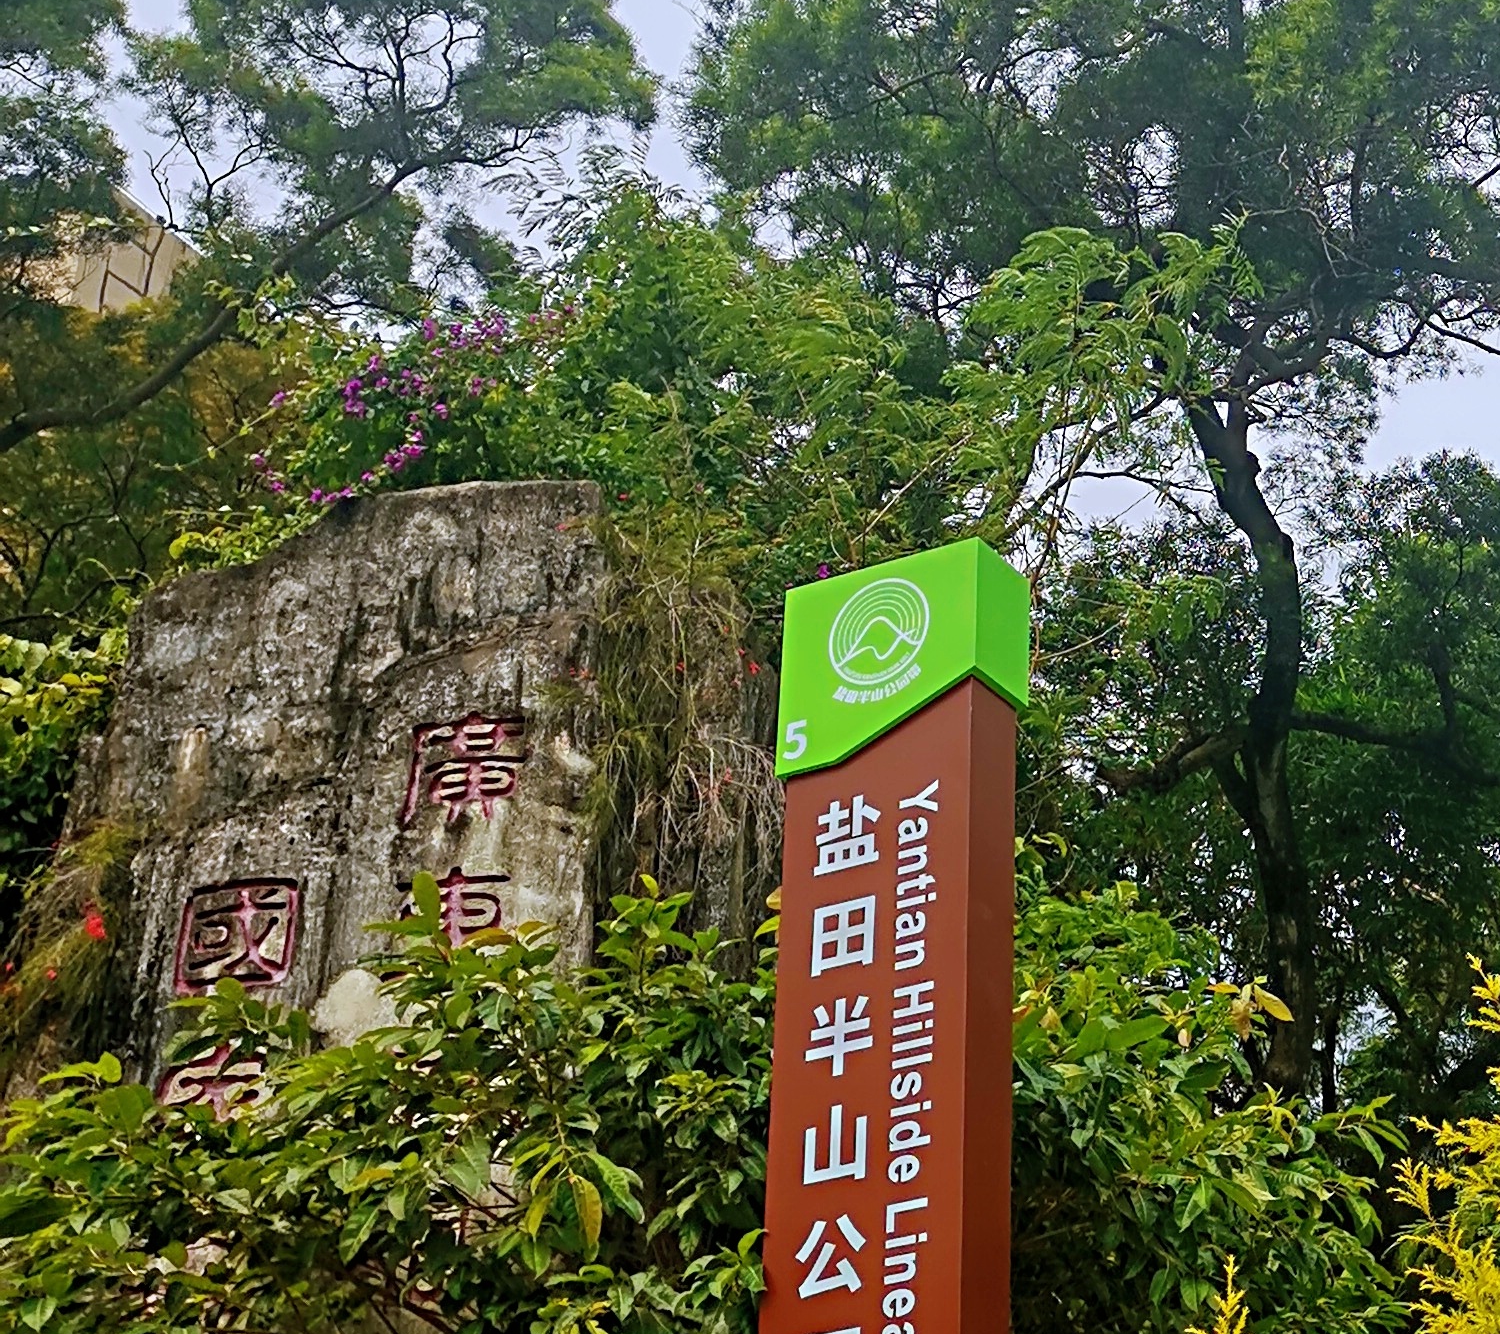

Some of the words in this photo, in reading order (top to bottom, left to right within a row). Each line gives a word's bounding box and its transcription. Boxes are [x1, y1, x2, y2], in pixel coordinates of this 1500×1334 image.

[782, 719, 808, 760] 5
[895, 779, 940, 971] Yantian
[888, 980, 935, 1183] Hillside
